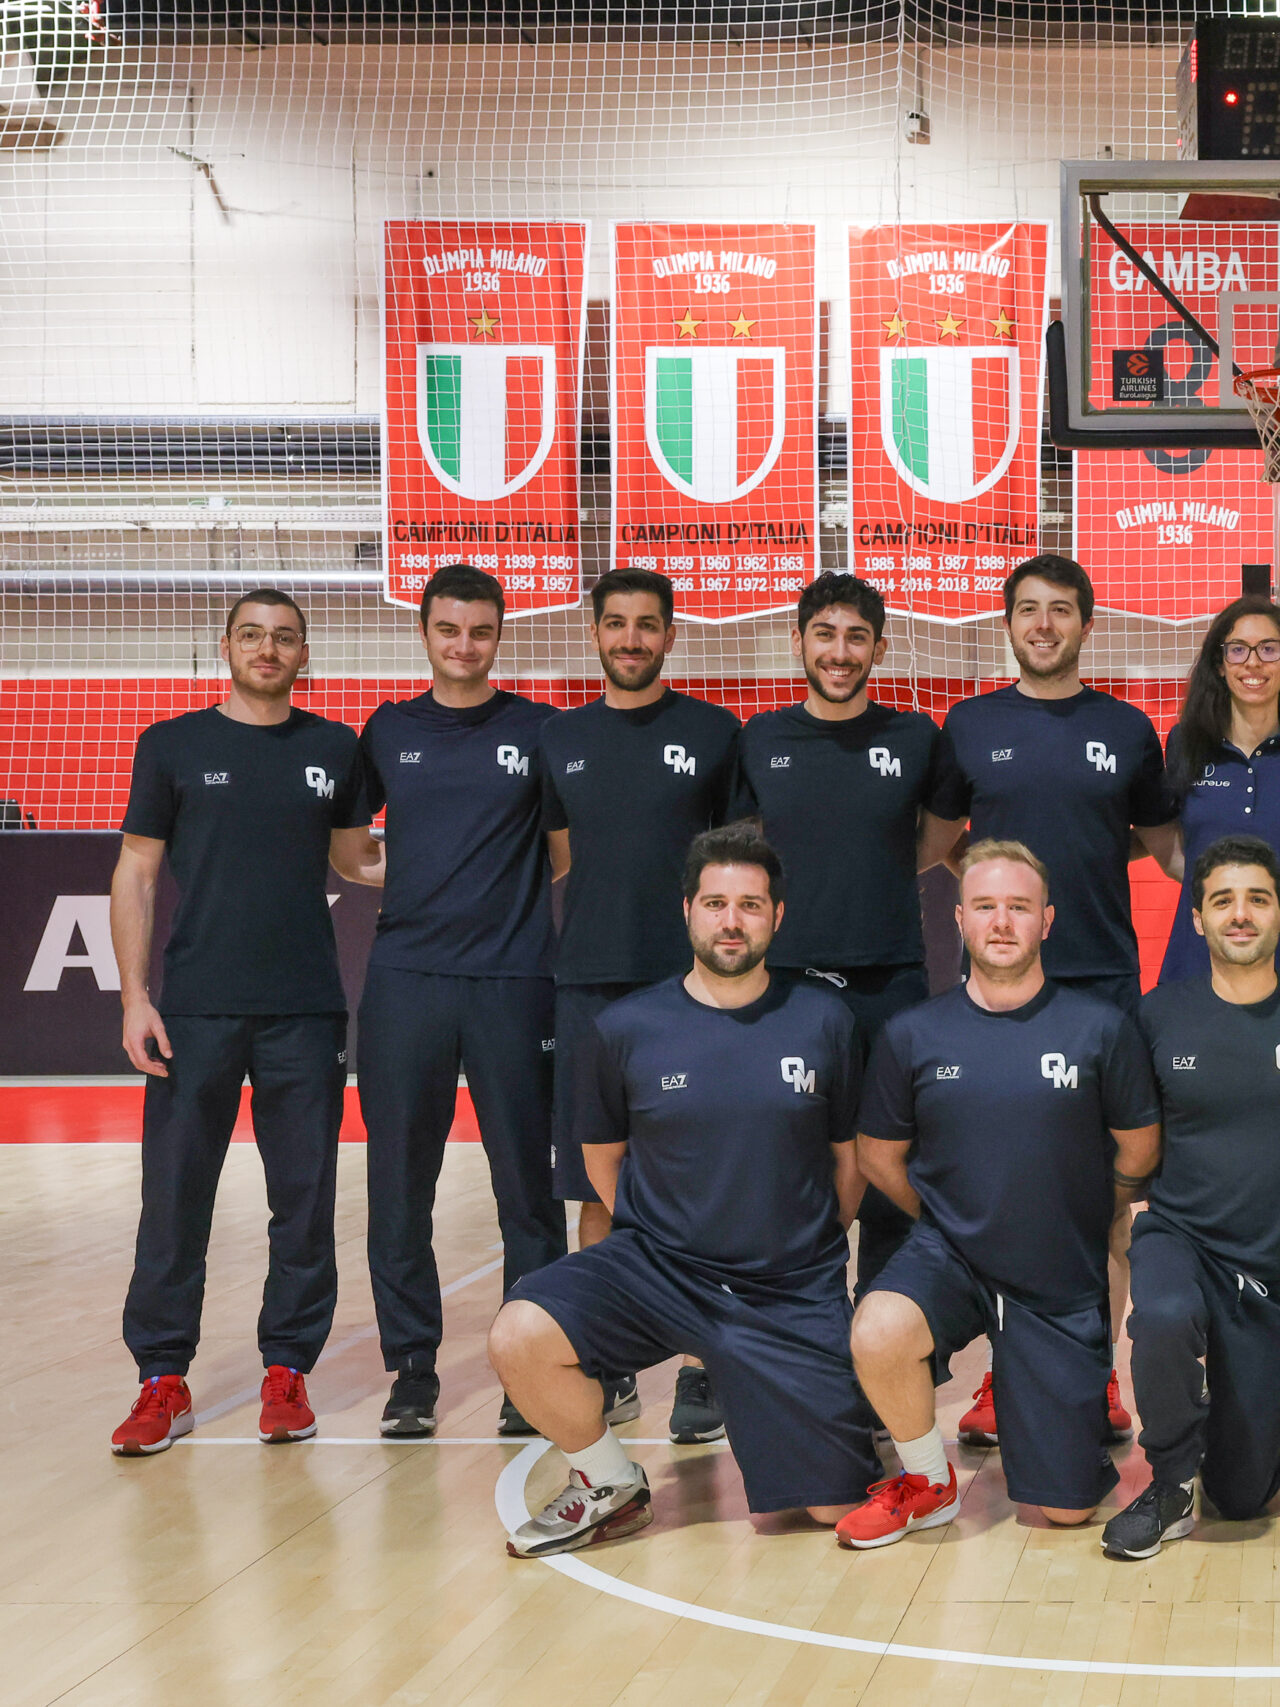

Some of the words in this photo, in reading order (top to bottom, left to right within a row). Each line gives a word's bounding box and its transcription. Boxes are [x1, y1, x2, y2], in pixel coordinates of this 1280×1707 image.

[422, 248, 485, 276] OLIMPIA
[490, 248, 547, 277] MILANO
[652, 250, 715, 278] OLIMPIA
[720, 250, 777, 279] MILANO
[886, 250, 949, 279] OLIMPIA
[953, 250, 1010, 278] MILANO
[1109, 250, 1248, 292] GAMBA
[464, 271, 500, 292] 1936
[694, 273, 731, 294] 1936
[928, 273, 965, 294] 1936
[1116, 501, 1177, 530] OLIMPIA
[1182, 501, 1240, 530] MILANO
[394, 520, 488, 542] CAMPIONI
[496, 521, 576, 542] D'ITALIA
[621, 523, 720, 545] CAMPIONI
[728, 523, 809, 545] D'ITALIA
[859, 523, 958, 546] CAMPIONI
[965, 523, 1036, 545] D'ITALIA
[1157, 524, 1193, 544] 1936
[400, 553, 430, 568] 1936
[467, 554, 498, 568] 1938
[504, 554, 536, 569] 1939
[542, 555, 573, 570] 1950
[627, 556, 657, 570] 1958
[663, 556, 694, 570] 1959
[700, 556, 730, 570] 1960
[736, 556, 767, 570] 1962
[773, 556, 804, 570] 1963
[864, 557, 895, 571] 1985
[901, 556, 932, 571] 1986
[937, 556, 968, 570] 1987
[975, 556, 1005, 570] 1989
[504, 576, 536, 590] 1954
[542, 577, 573, 591] 1957
[671, 577, 694, 591] 966
[700, 577, 730, 591] 1967
[736, 577, 767, 591] 1972
[773, 577, 803, 591] 1982
[900, 577, 932, 592] 2016
[937, 577, 969, 591] 2018
[975, 577, 1005, 591] 2022
[400, 752, 421, 761] EA7
[770, 757, 790, 766] EA7
[992, 748, 1013, 760] EA7
[204, 772, 228, 782] EA7
[1172, 1056, 1196, 1067] EA7
[936, 1066, 960, 1076] EA7
[661, 1074, 687, 1087] EA7
